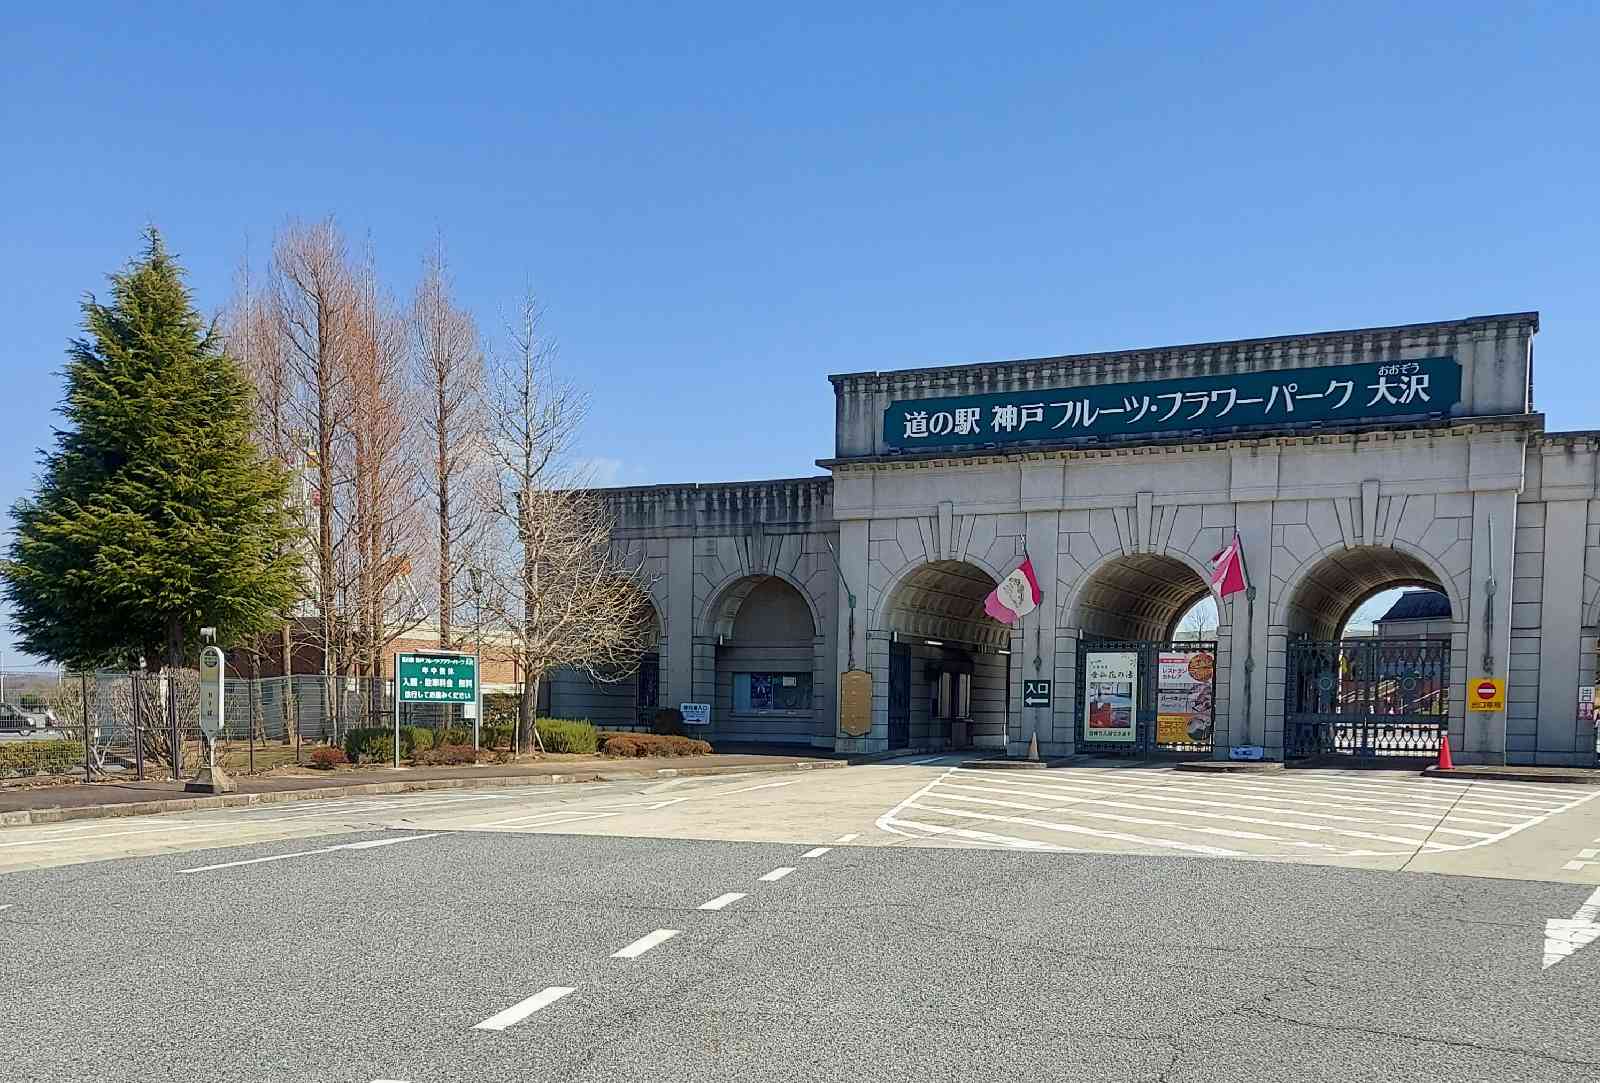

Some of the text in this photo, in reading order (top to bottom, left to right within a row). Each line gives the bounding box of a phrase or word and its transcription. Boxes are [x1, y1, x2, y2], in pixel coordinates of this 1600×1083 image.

[1377, 362, 1421, 377] おおぞう
[903, 407, 981, 439] 道の駅
[1366, 374, 1432, 408] 大沢
[1026, 682, 1048, 694] 入口
